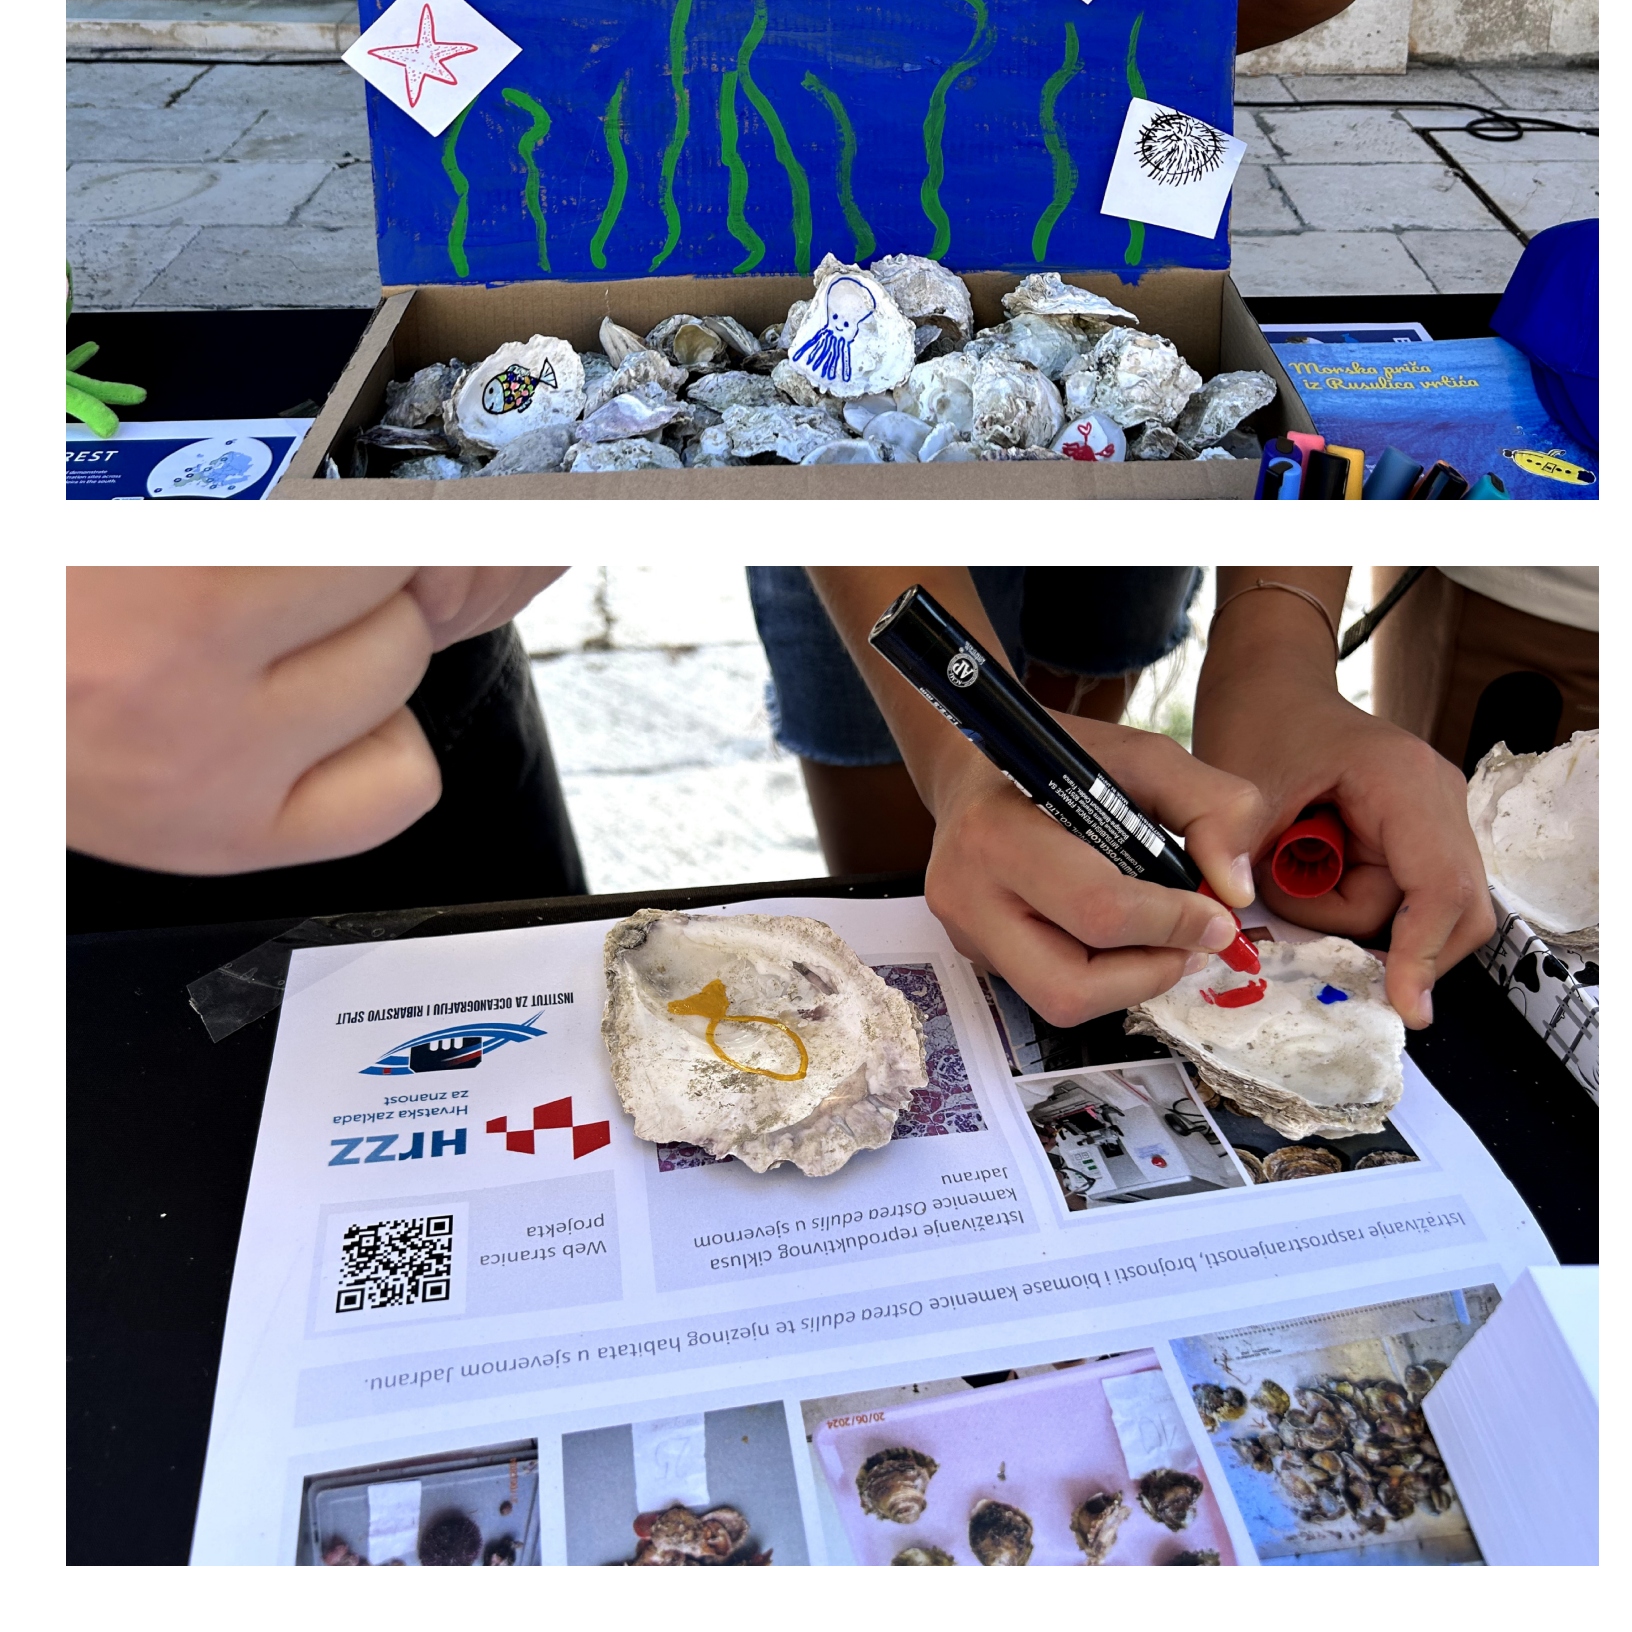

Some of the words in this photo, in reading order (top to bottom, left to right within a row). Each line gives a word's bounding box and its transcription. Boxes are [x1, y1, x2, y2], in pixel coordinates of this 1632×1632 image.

[1288, 361, 1379, 375] Morska
[1382, 361, 1432, 380] priča
[1302, 378, 1323, 390] iz
[1419, 375, 1480, 389] vrtića
[950, 656, 974, 680] AP
[1047, 779, 1058, 790] SA
[1061, 773, 1078, 790] France
[1054, 786, 1077, 809] FRANCE
[1064, 786, 1080, 801] 92517
[1074, 804, 1094, 825] PENCIL
[1077, 798, 1094, 815] Grenier
[1088, 799, 1130, 840] Boulogne-Billancourt
[1091, 811, 1106, 826] Pierre
[1090, 820, 1120, 850] MITSUBISHI
[1102, 822, 1120, 839] Avenue
[1119, 848, 1138, 867] contact
[1134, 863, 1144, 873] EU
[432, 995, 513, 1017] OCEANOGRAFIJU
[514, 995, 528, 1009] ZA
[528, 990, 574, 1008] INSTITUT
[334, 1009, 365, 1025] SPLIT
[366, 1003, 424, 1023] RIBARSTVO
[382, 1090, 447, 1107] znanost
[450, 1088, 469, 1099] za
[331, 1109, 395, 1127] zaklada
[397, 1102, 469, 1122] Hrvatska
[939, 1165, 1009, 1188] Jadranu
[867, 1199, 928, 1222] Ostrea
[930, 1186, 1017, 1213] kamenice
[525, 1213, 606, 1239] projekta
[794, 1218, 806, 1231] u
[809, 1208, 864, 1231] edulis
[921, 1208, 1025, 1238] Istraživanje
[1366, 1208, 1466, 1244] Istraživanje
[691, 1221, 791, 1250] sjevernom
[776, 1224, 919, 1261] reproduktivnog
[478, 1245, 556, 1268] stranica
[560, 1239, 607, 1258] Web
[1195, 1224, 1366, 1271] rasprostranjenosti,
[707, 1248, 773, 1271] ciklusa
[1111, 1253, 1196, 1286] brojnosti
[1020, 1271, 1101, 1301] biomase
[927, 1283, 1019, 1315] kamenice
[797, 1308, 857, 1335] edulis
[858, 1299, 924, 1326] Ostrea
[684, 1317, 771, 1351] njezinog
[773, 1317, 795, 1337] te
[575, 1346, 590, 1363] u
[594, 1333, 682, 1364] habitata
[457, 1344, 573, 1382] sjevernom
[361, 1362, 457, 1395] Jadranu.
[825, 1410, 885, 1429] 20/06/2024
